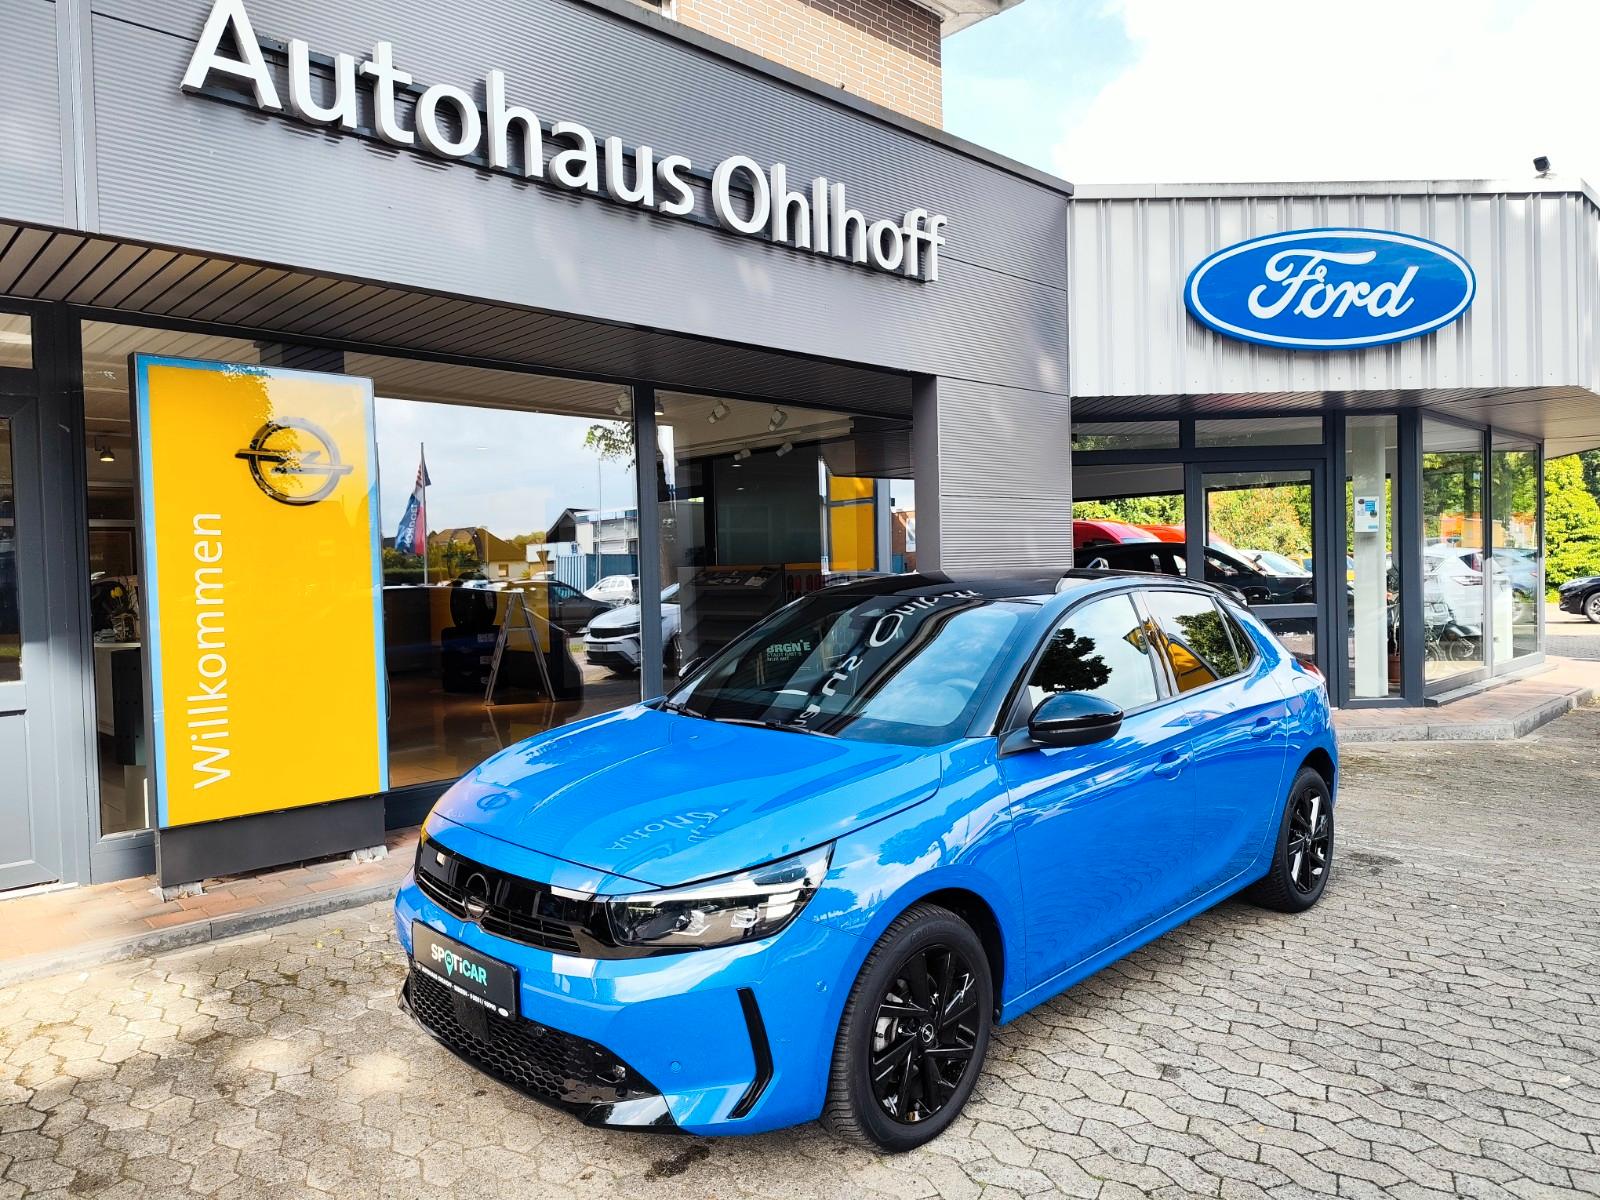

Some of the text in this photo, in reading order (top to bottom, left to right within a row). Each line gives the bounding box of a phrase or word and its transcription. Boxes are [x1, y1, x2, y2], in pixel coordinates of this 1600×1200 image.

[180, 0, 948, 282] Autohaus Ohlhoff
[1247, 248, 1420, 319] Ford
[187, 513, 231, 790] Willkommen
